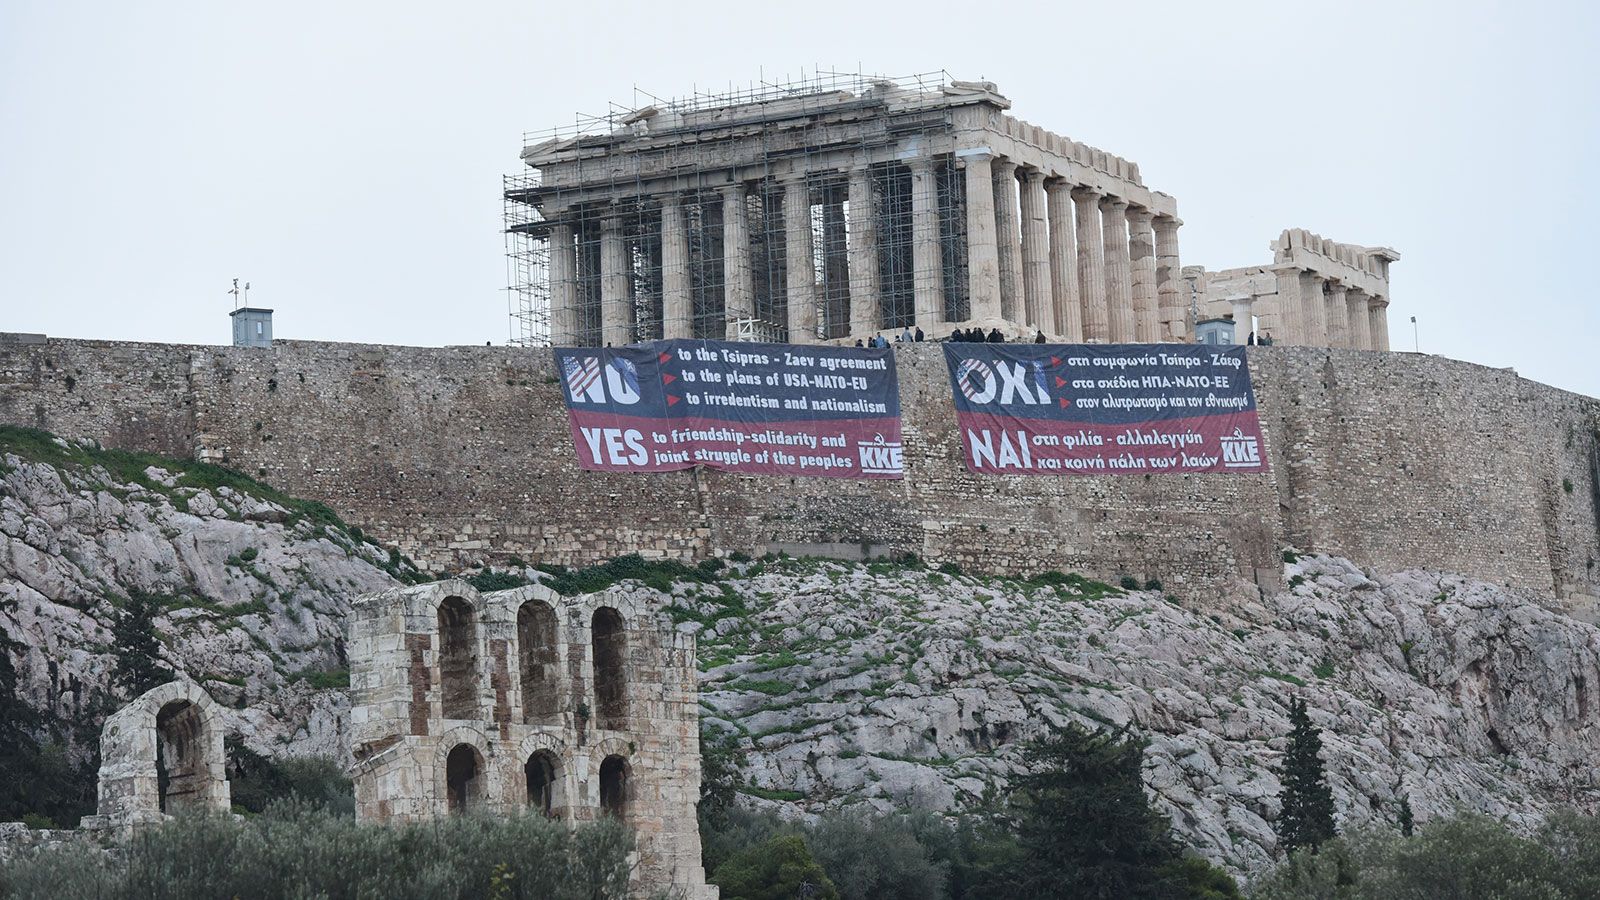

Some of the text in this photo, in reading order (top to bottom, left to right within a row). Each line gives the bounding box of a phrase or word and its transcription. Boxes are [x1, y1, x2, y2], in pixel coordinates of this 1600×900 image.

[678, 348, 691, 361] to
[696, 348, 718, 362] the
[721, 349, 769, 366] Tsipras
[785, 353, 814, 367] Zaev
[820, 356, 886, 371] agreement
[1068, 357, 1090, 366] στη
[1093, 354, 1157, 369] συμφωνία
[1159, 354, 1200, 368] Τσίπρα
[1210, 354, 1242, 369] Ζάεφ
[562, 356, 640, 404] NO
[682, 368, 868, 390] to the plans of USA-NATO-EU
[956, 358, 1052, 404] ΟΧΙ
[1072, 380, 1094, 388] στα
[1098, 376, 1140, 389] σχέδια
[686, 392, 886, 414] to irredentism and nationalism
[1076, 392, 1248, 411] στον αλυτρωτισμό και τον εθνικισμό
[580, 426, 648, 466] YES
[652, 428, 846, 448] to friendship-solidarity and
[968, 428, 1032, 468] ΝΑΙ
[1032, 436, 1060, 446] στη
[1062, 430, 1103, 449] φιλία
[1116, 430, 1203, 448] αλληλεγγύη
[654, 446, 852, 470] joint struggle of the peoples
[858, 447, 902, 468] KKE
[1038, 452, 1218, 468] και κοινή πάλη των λαών
